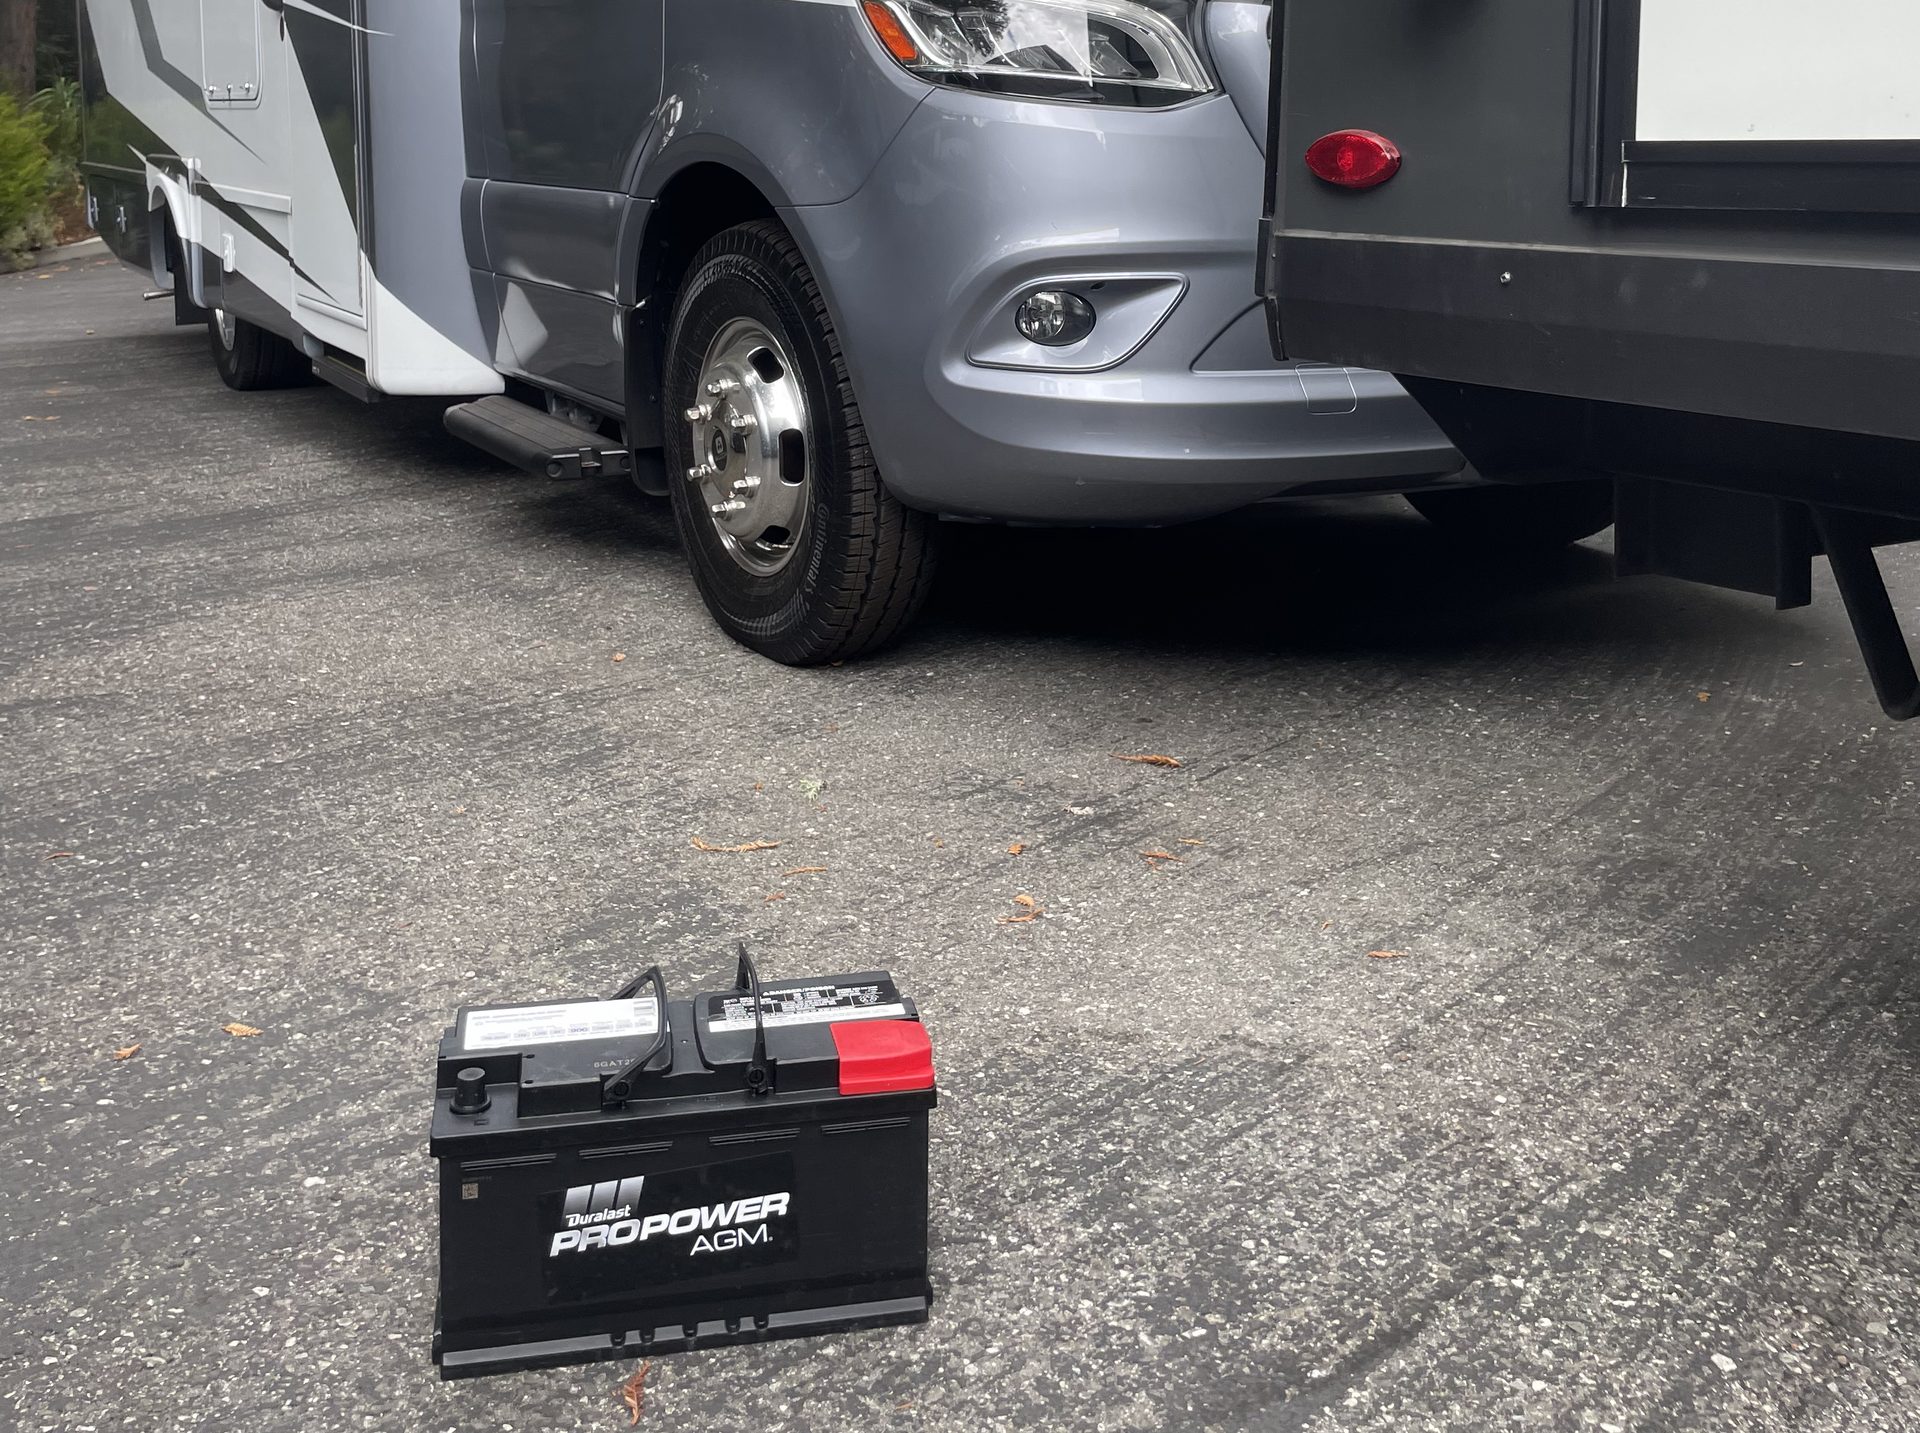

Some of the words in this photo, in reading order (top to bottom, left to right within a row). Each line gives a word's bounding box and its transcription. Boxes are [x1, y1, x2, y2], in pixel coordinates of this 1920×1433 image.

[806, 502, 831, 588] Continental
[549, 1191, 790, 1257] PROPOWER
[565, 1204, 632, 1228] Duralast
